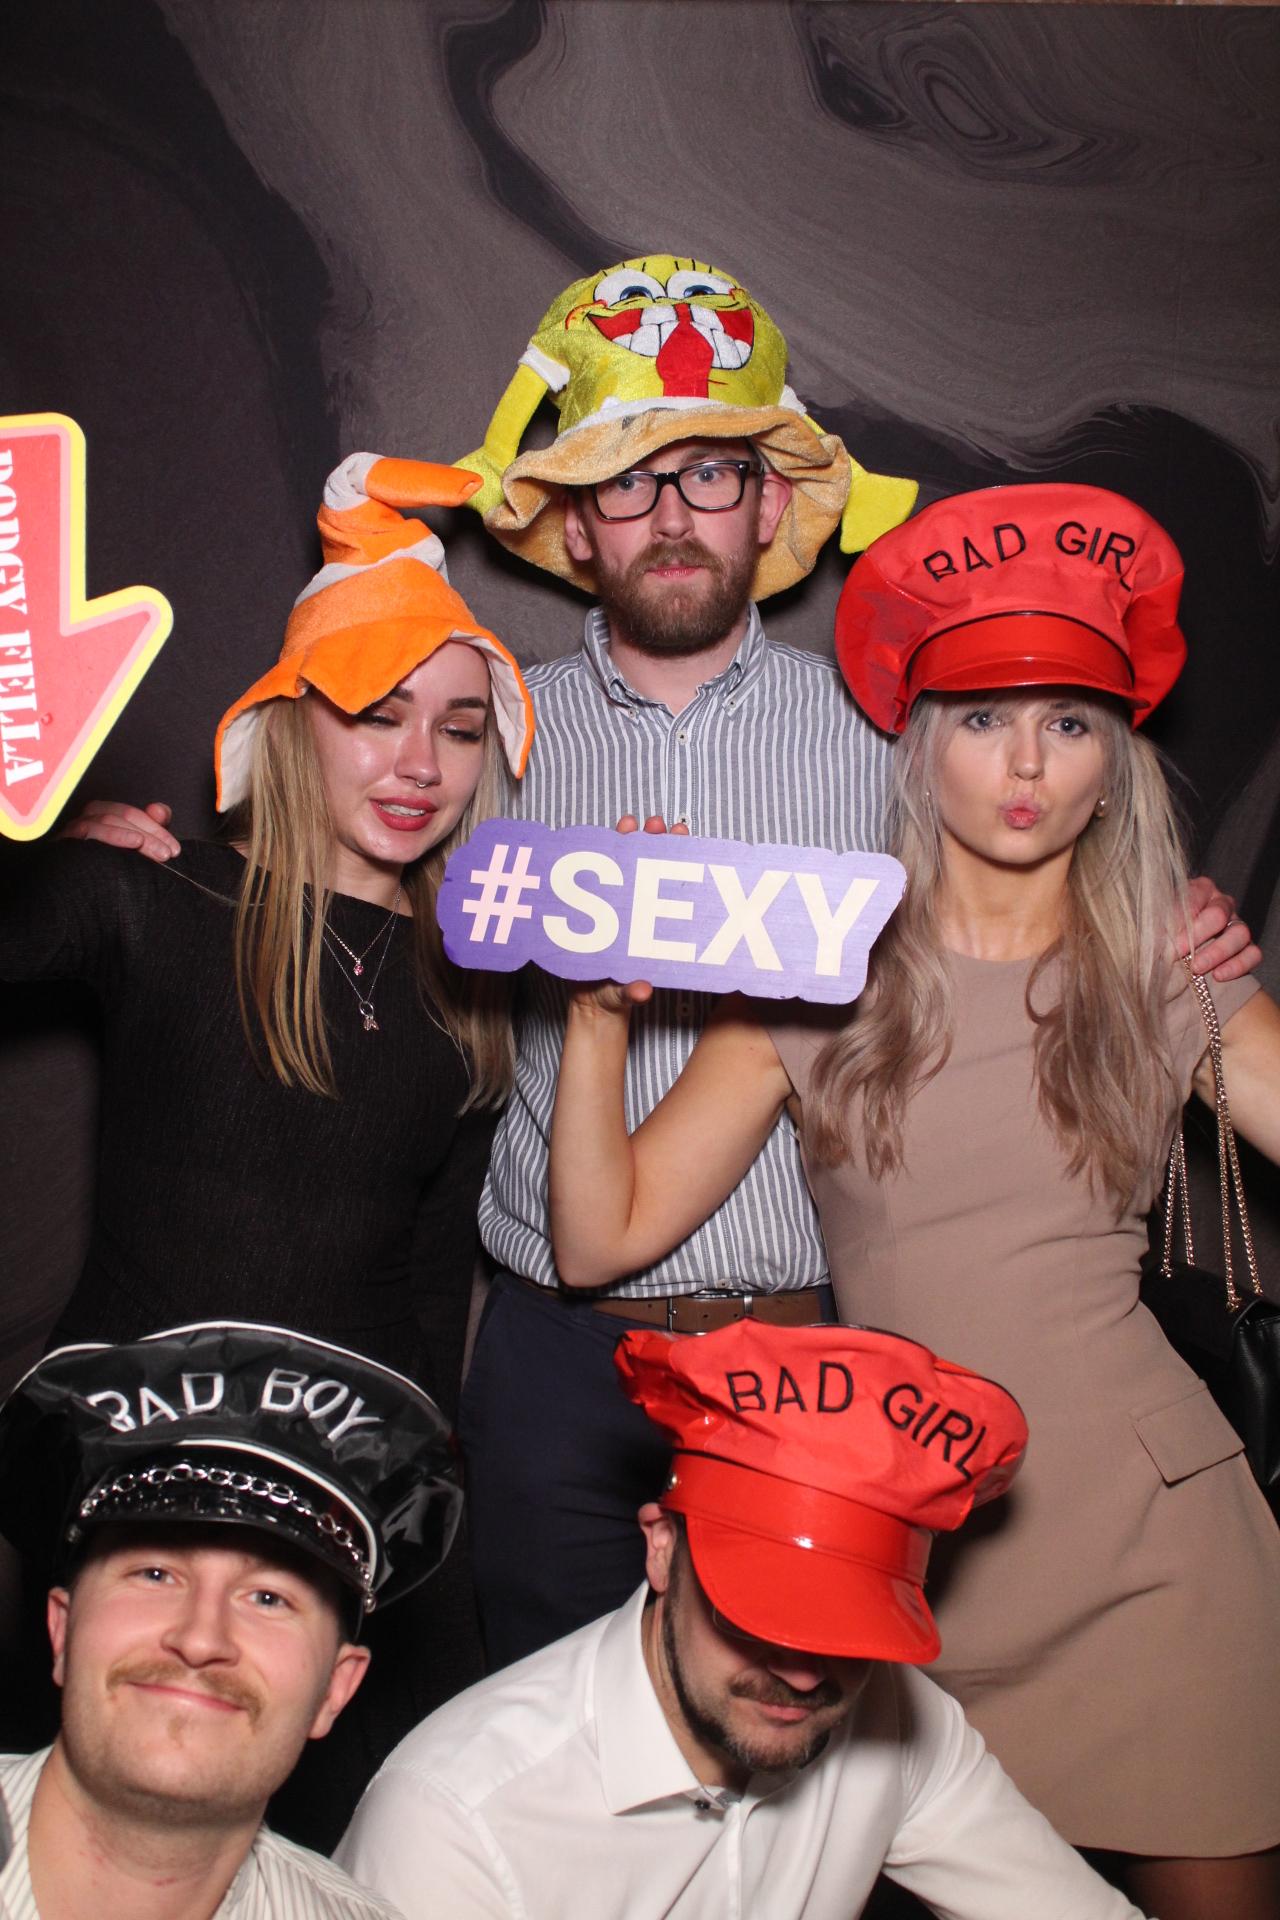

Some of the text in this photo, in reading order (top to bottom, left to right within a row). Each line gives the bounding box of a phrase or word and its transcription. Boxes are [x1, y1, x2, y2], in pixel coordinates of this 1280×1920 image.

[922, 521, 1136, 593] BAD GIR
[0, 629, 44, 787] FELLA
[462, 844, 880, 977] #SEXY
[260, 1368, 385, 1441] BOY
[726, 1361, 987, 1481] BAD GIRL
